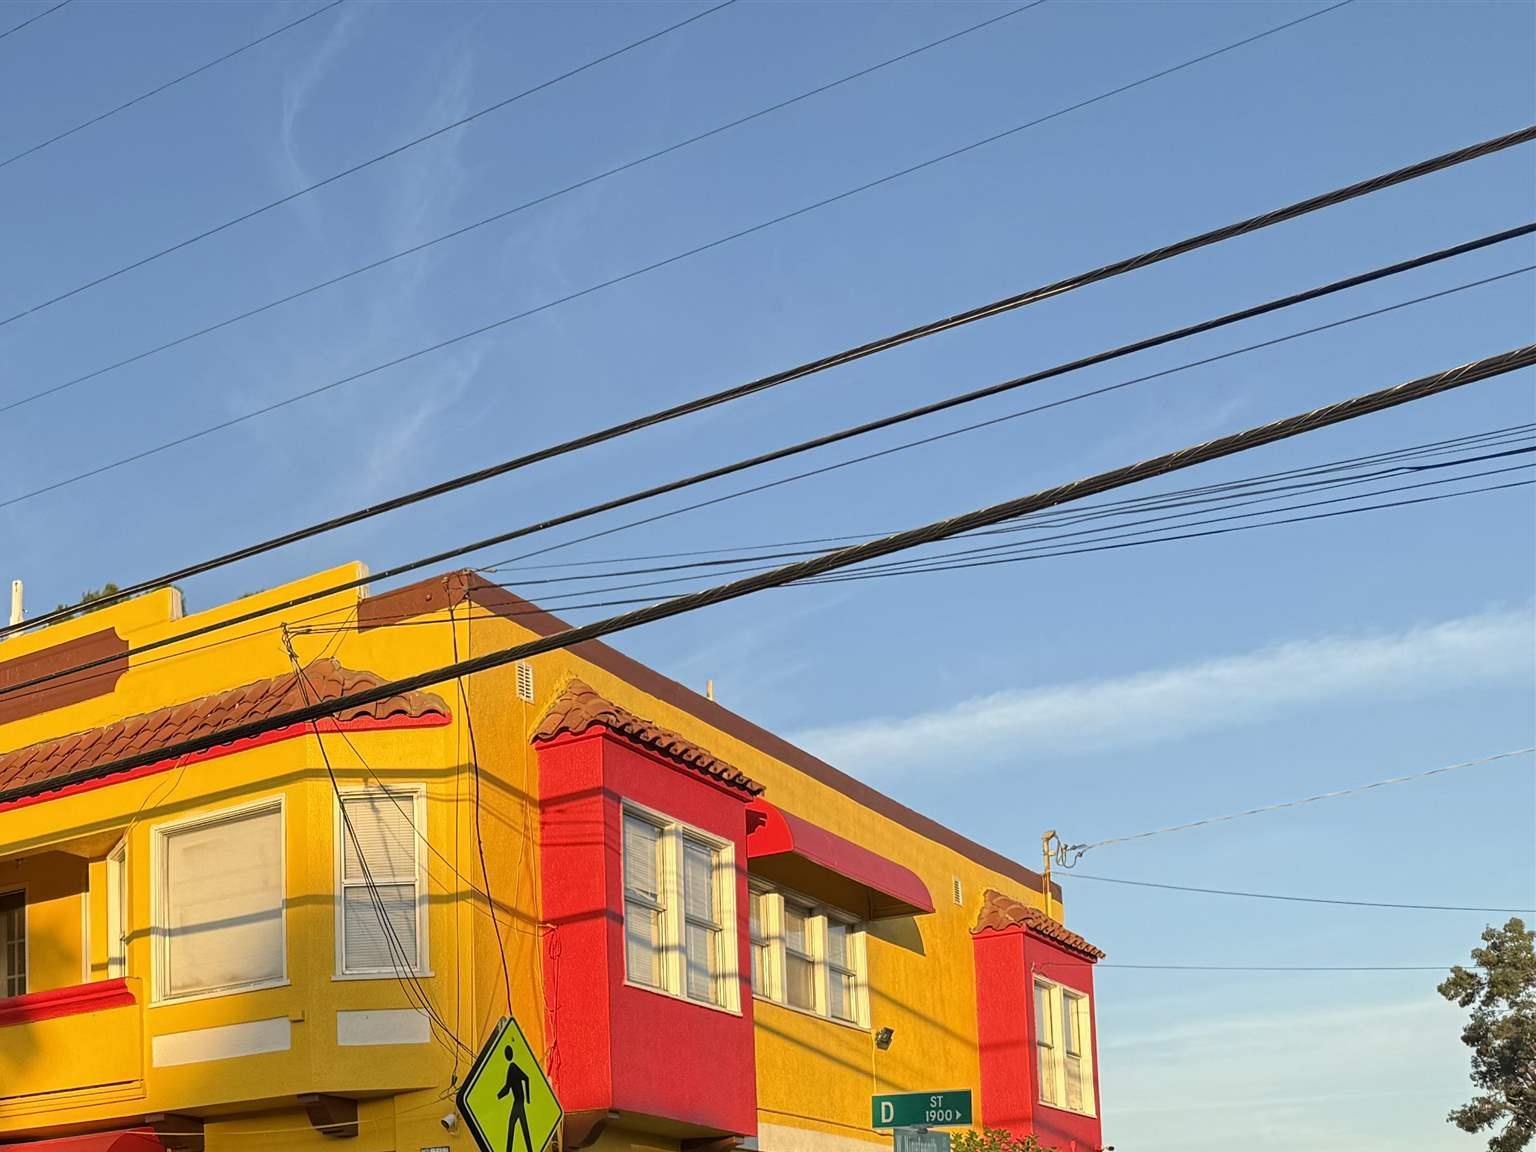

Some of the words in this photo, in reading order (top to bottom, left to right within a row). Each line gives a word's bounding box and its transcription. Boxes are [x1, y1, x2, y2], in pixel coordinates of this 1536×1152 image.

[881, 1101, 894, 1123] D
[930, 1096, 943, 1108] ST
[926, 1109, 952, 1122] 1900
